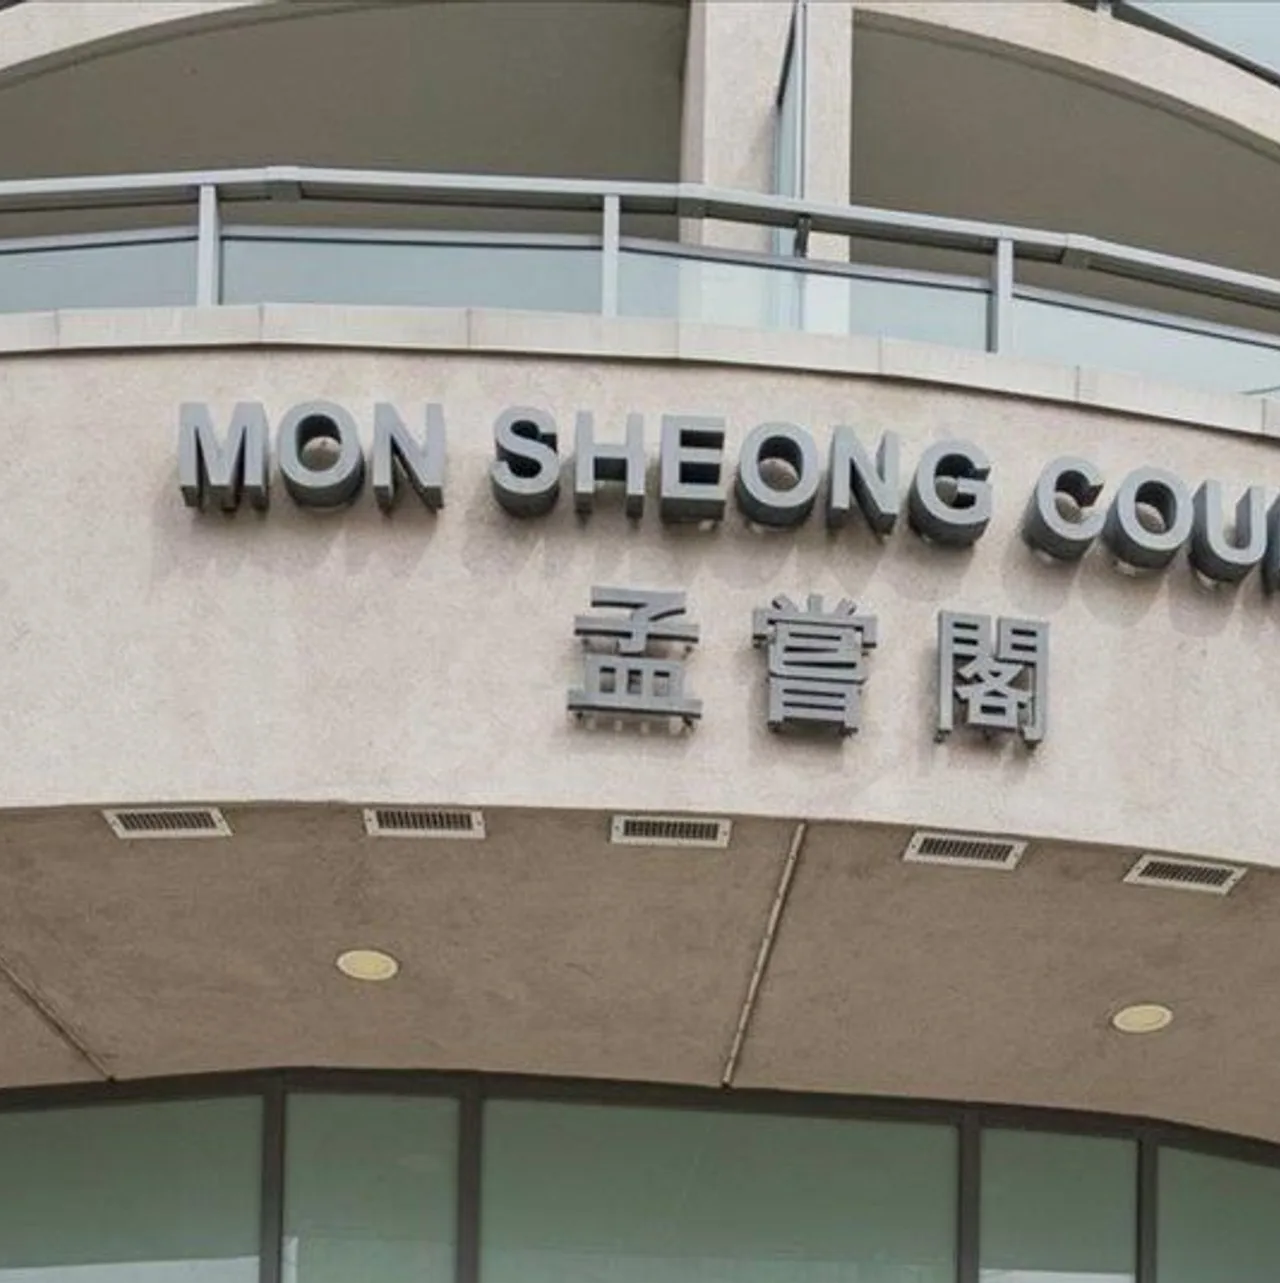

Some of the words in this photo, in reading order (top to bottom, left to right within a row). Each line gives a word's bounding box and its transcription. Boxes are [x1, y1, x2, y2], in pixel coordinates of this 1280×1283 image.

[179, 400, 444, 510] MON
[490, 405, 994, 547] SHEONG
[567, 585, 1051, 744] 孟嘗閣
